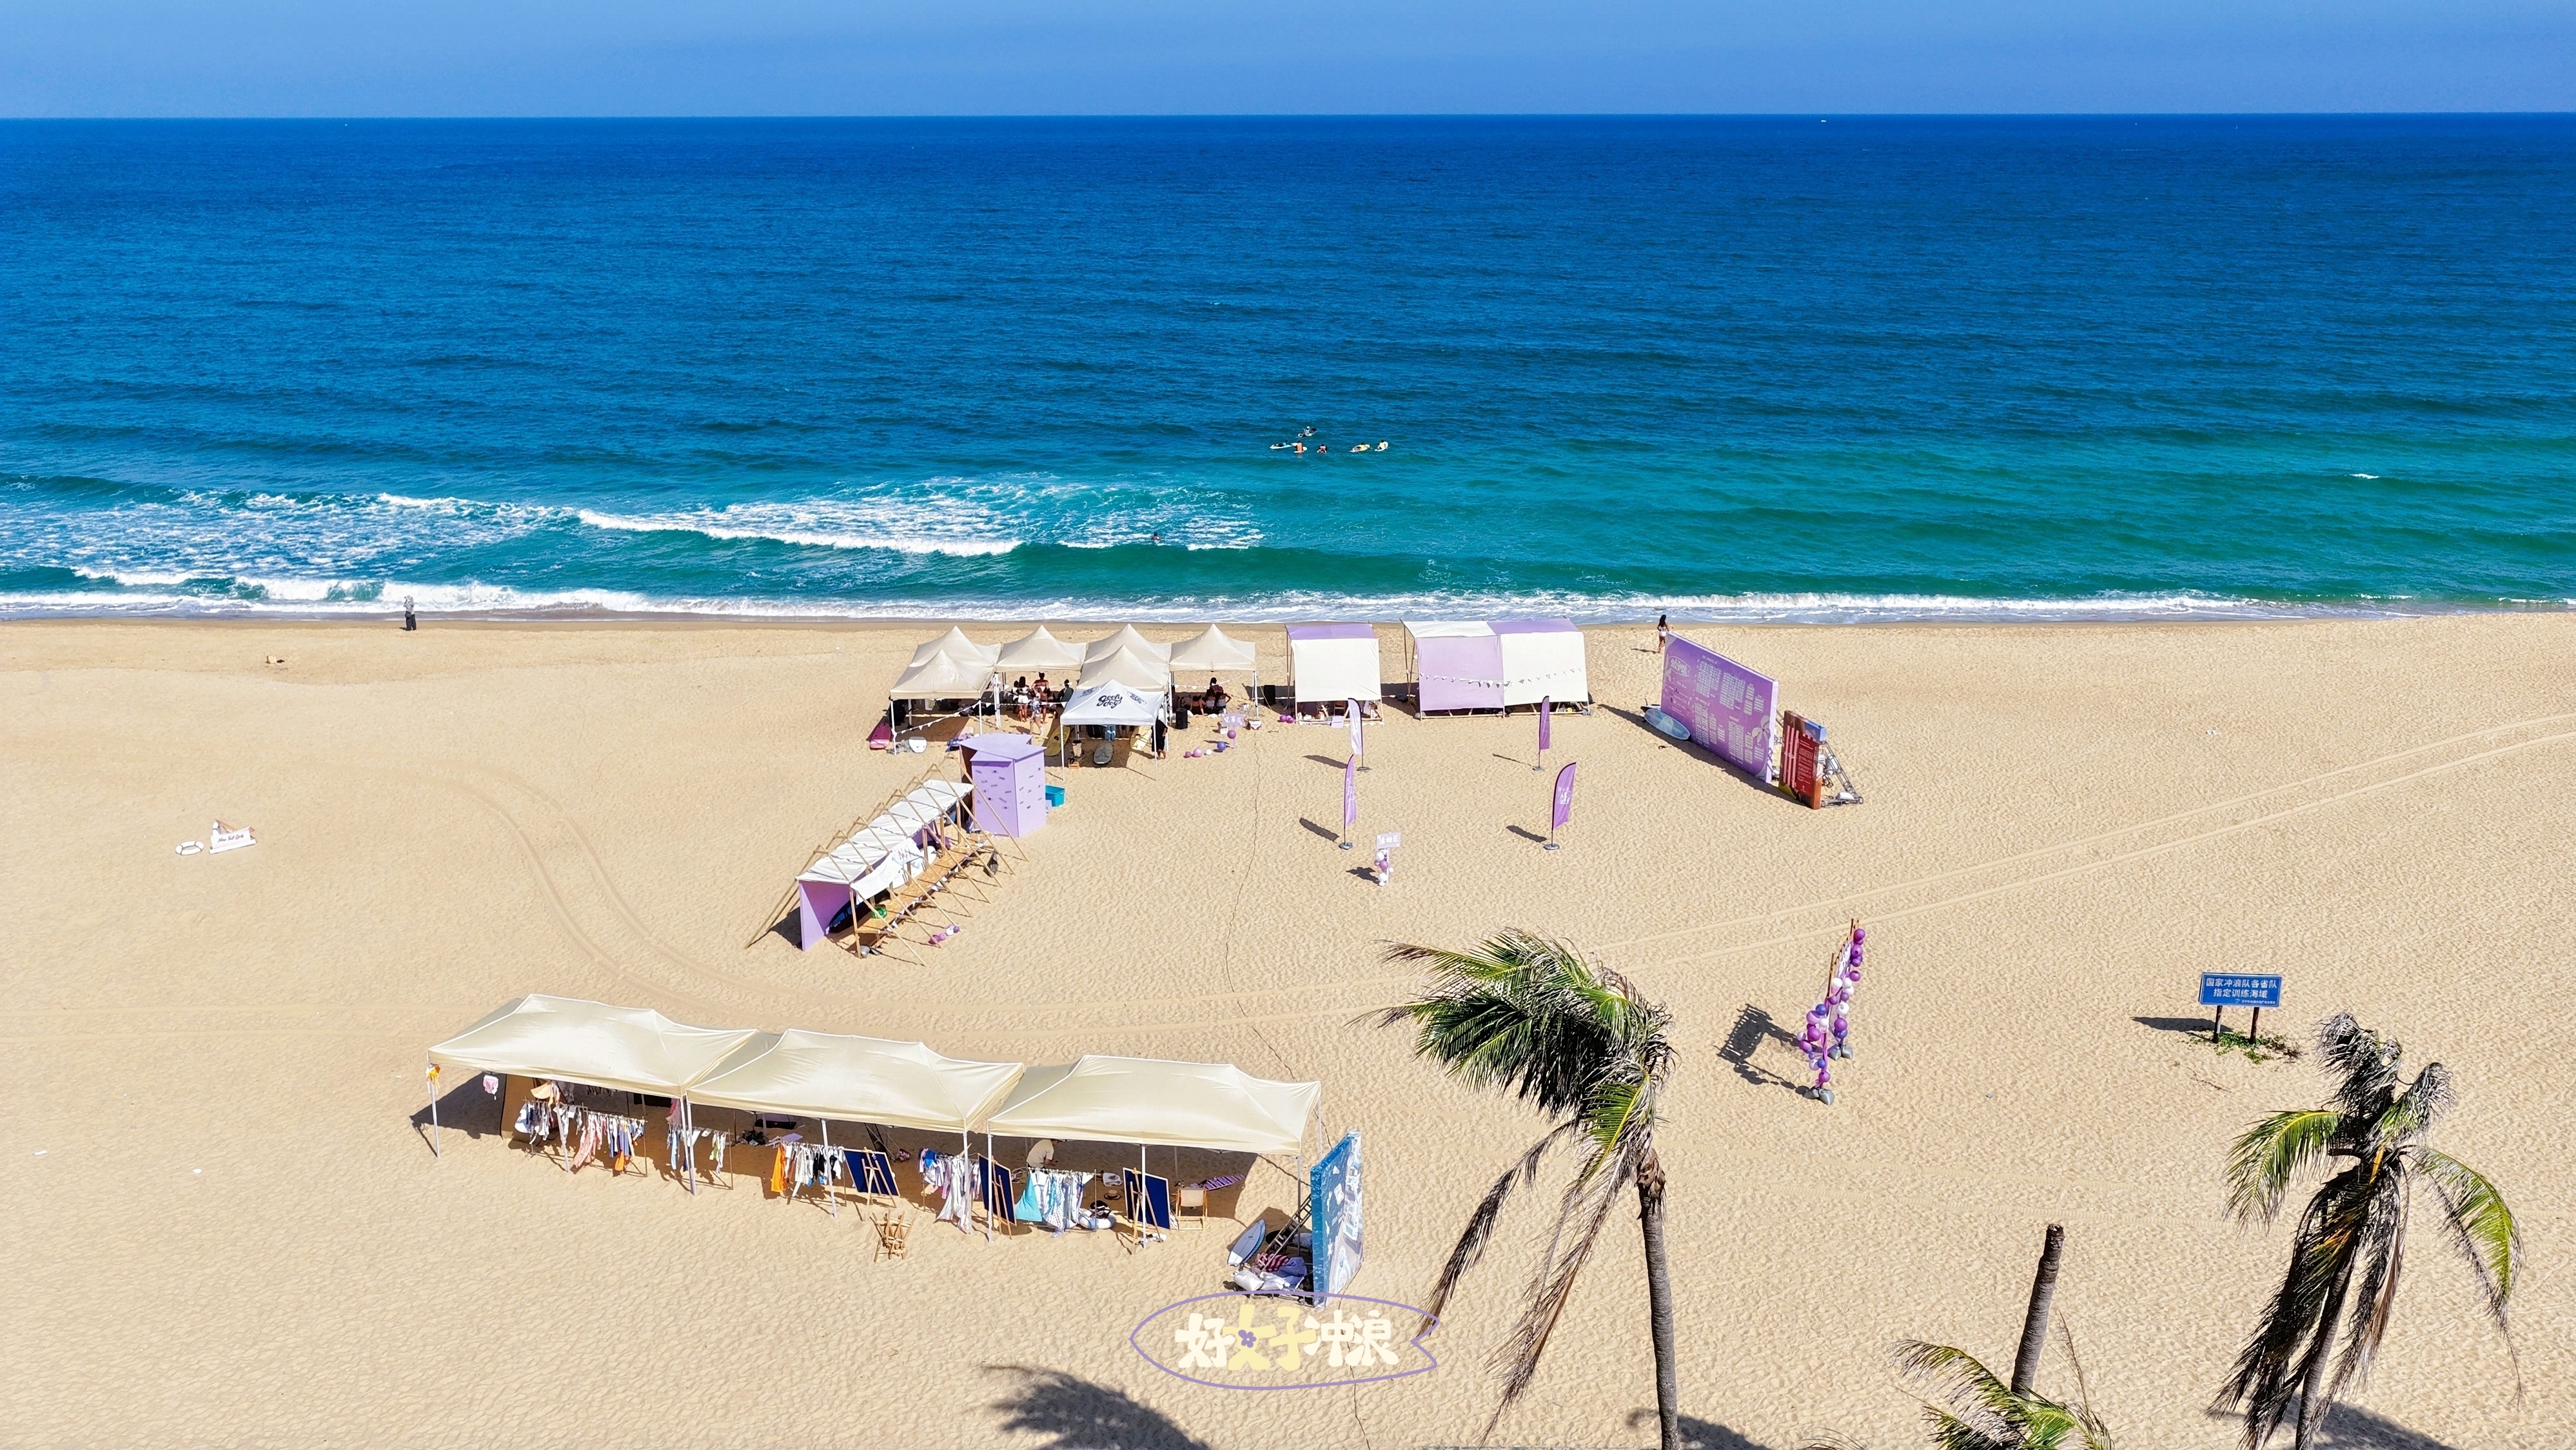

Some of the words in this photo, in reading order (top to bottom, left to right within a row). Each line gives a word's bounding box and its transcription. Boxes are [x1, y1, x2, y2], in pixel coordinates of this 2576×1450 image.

[1096, 694, 1123, 706] goofy
[1103, 699, 1121, 709] dog
[2206, 978, 2277, 989] 国家冲浪队各省队
[2213, 988, 2268, 999] 指定训练海域
